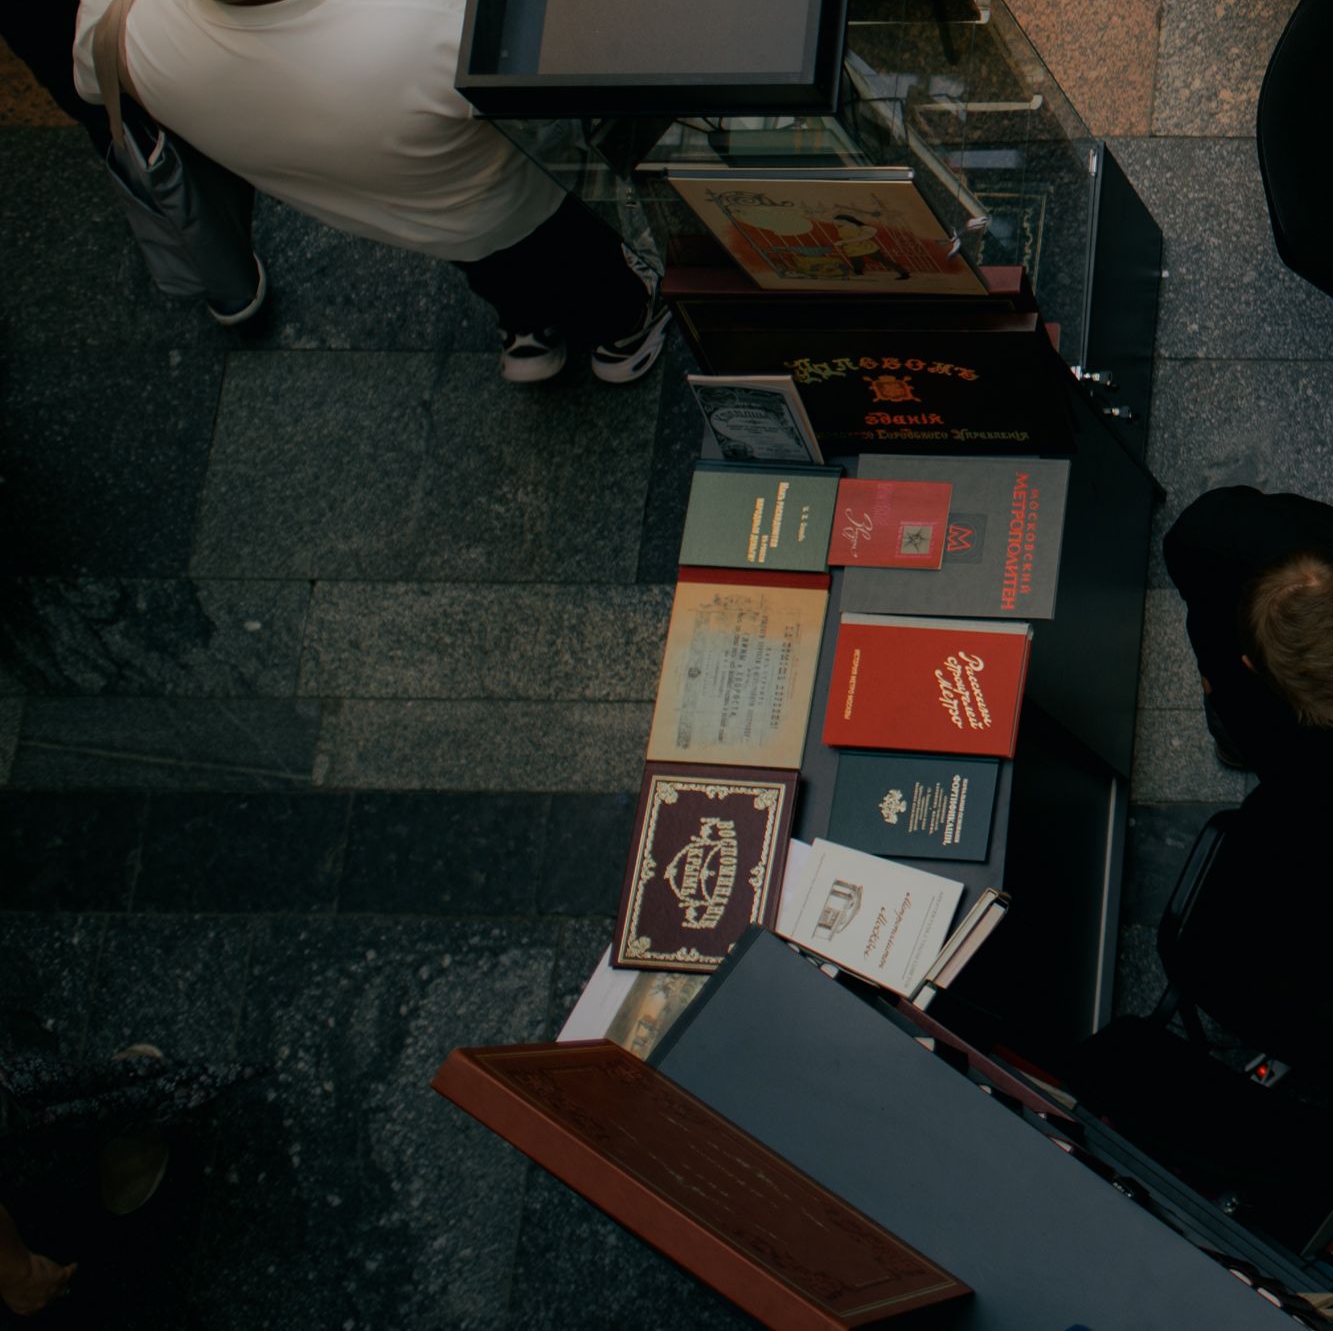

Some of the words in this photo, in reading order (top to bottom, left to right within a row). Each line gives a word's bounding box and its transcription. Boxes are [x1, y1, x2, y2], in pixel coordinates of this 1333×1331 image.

[1001, 472, 1030, 610] МЕТРОПОЛИТЕН
[1019, 488, 1040, 594] МОСКОВСКИЙ
[958, 650, 992, 728] Рассказы
